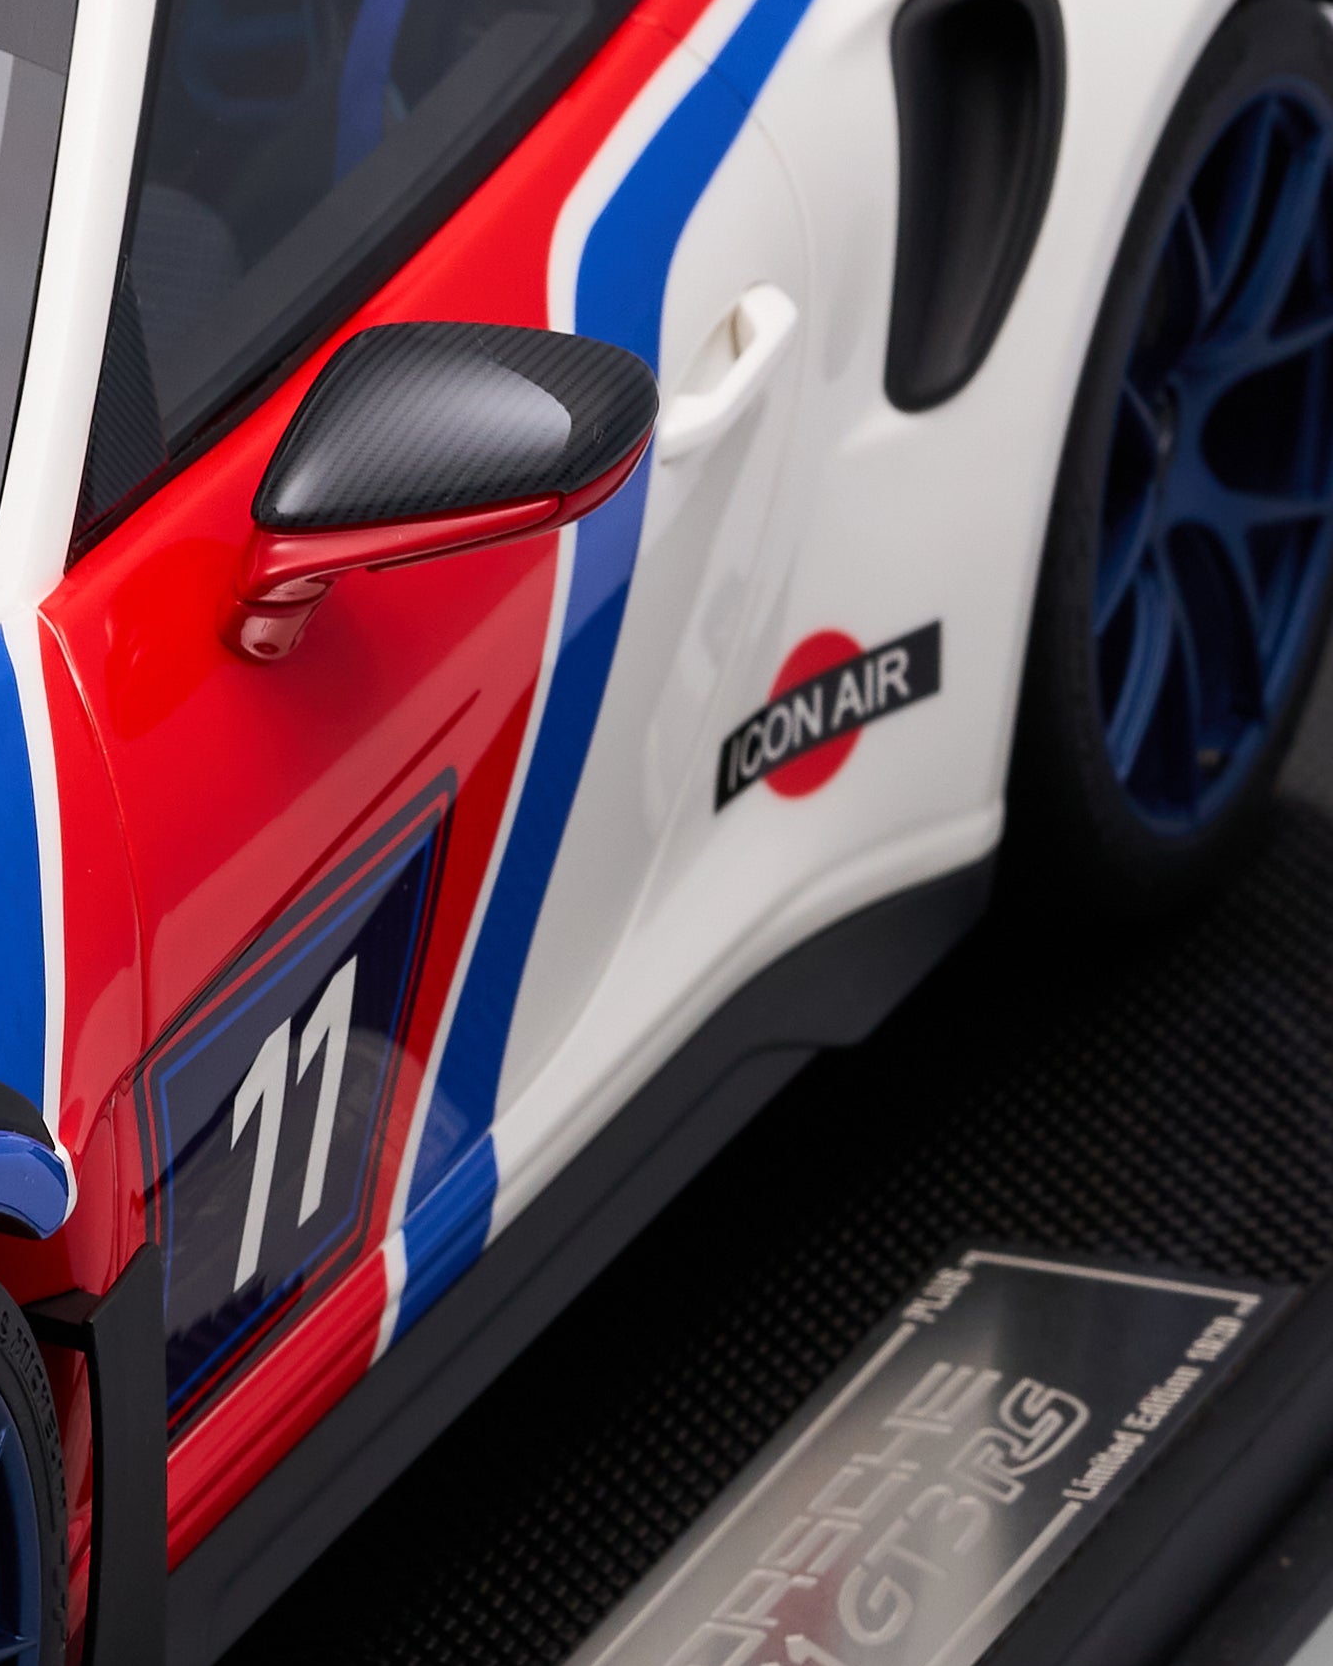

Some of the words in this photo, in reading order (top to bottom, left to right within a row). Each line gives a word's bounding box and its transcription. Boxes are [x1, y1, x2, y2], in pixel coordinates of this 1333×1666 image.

[728, 683, 824, 792] ICON
[832, 648, 910, 727] AIR
[231, 957, 356, 1290] 11
